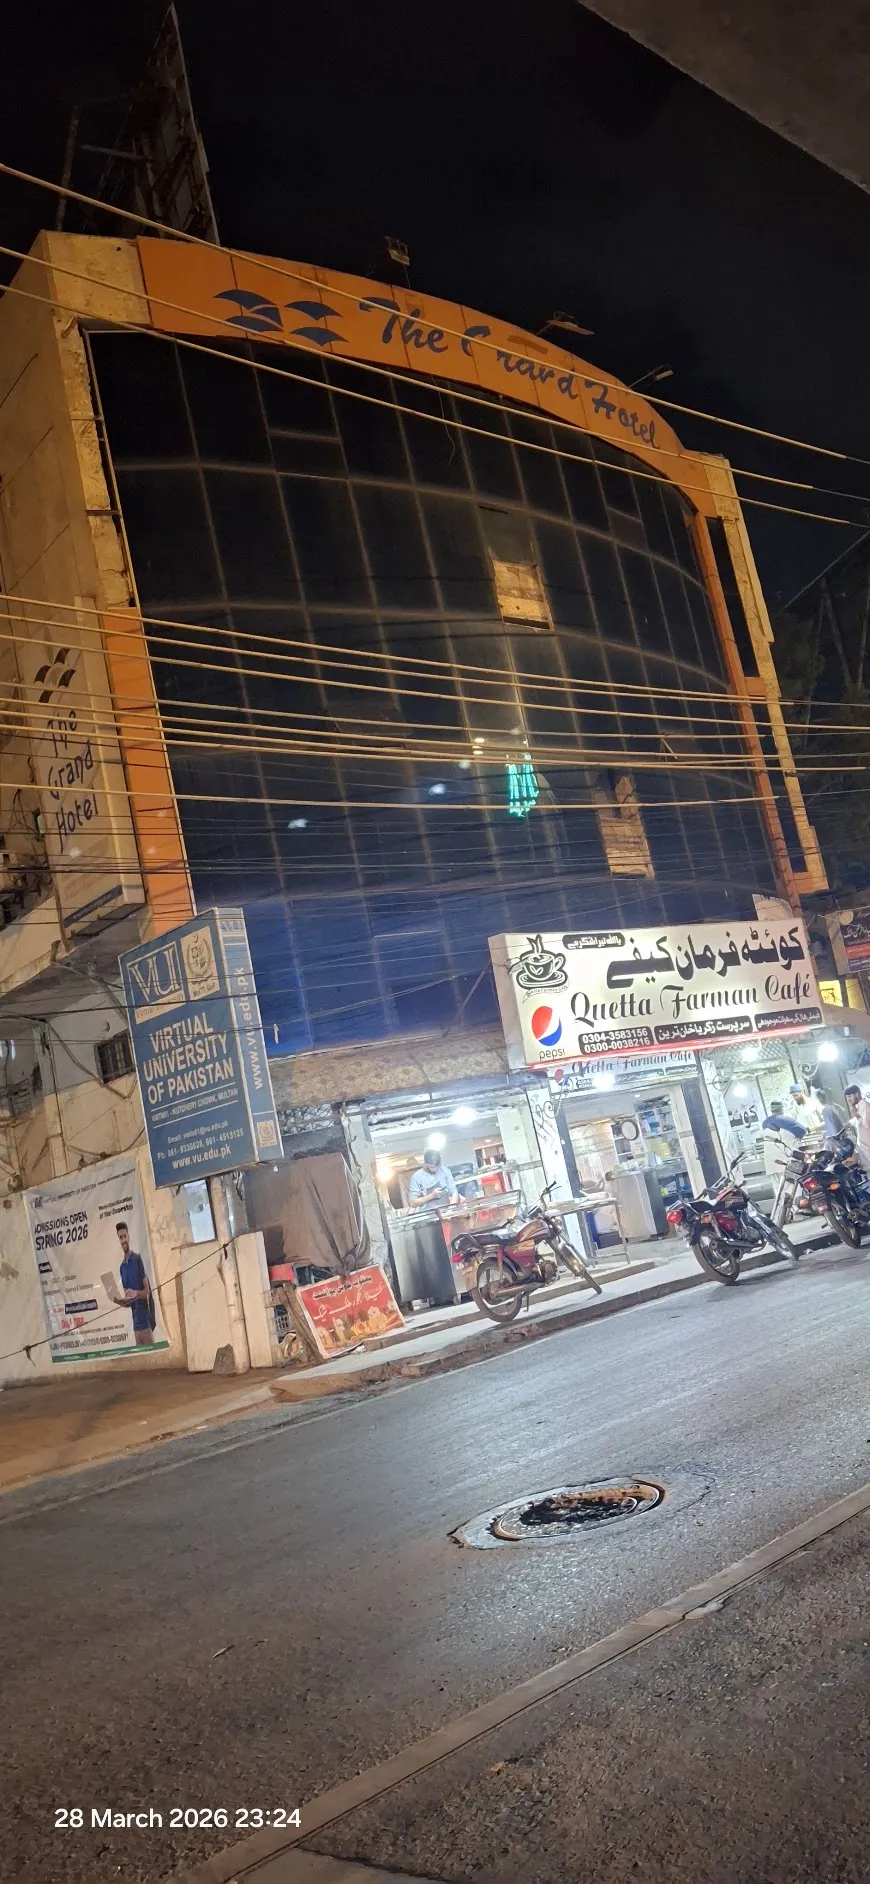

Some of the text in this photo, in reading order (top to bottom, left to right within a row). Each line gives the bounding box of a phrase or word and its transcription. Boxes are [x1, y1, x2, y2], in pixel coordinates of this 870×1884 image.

[359, 297, 448, 353] The
[584, 379, 660, 449] Hotel
[47, 710, 77, 758] The
[48, 739, 93, 800] Grand
[56, 784, 98, 854] Hotel
[222, 920, 242, 933] VU
[128, 948, 181, 1003] VU
[607, 926, 805, 989] کوئٹہ فرمان کیفے
[571, 973, 812, 1028] Quetta Farman Café
[149, 1012, 214, 1054] VIRTUAL
[234, 967, 263, 1090] www.vu.edu.pk
[582, 1027, 649, 1044] 0304-3583156
[584, 1037, 651, 1053] 0300-0038216
[143, 1032, 228, 1082] UNIVERSITY
[538, 1047, 565, 1062] pepsi
[148, 1057, 235, 1105] OF PAKISTAN
[172, 1143, 231, 1169] www.vu.edu.pk
[65, 1223, 88, 1242] 2026
[69, 1210, 88, 1227] OPEN
